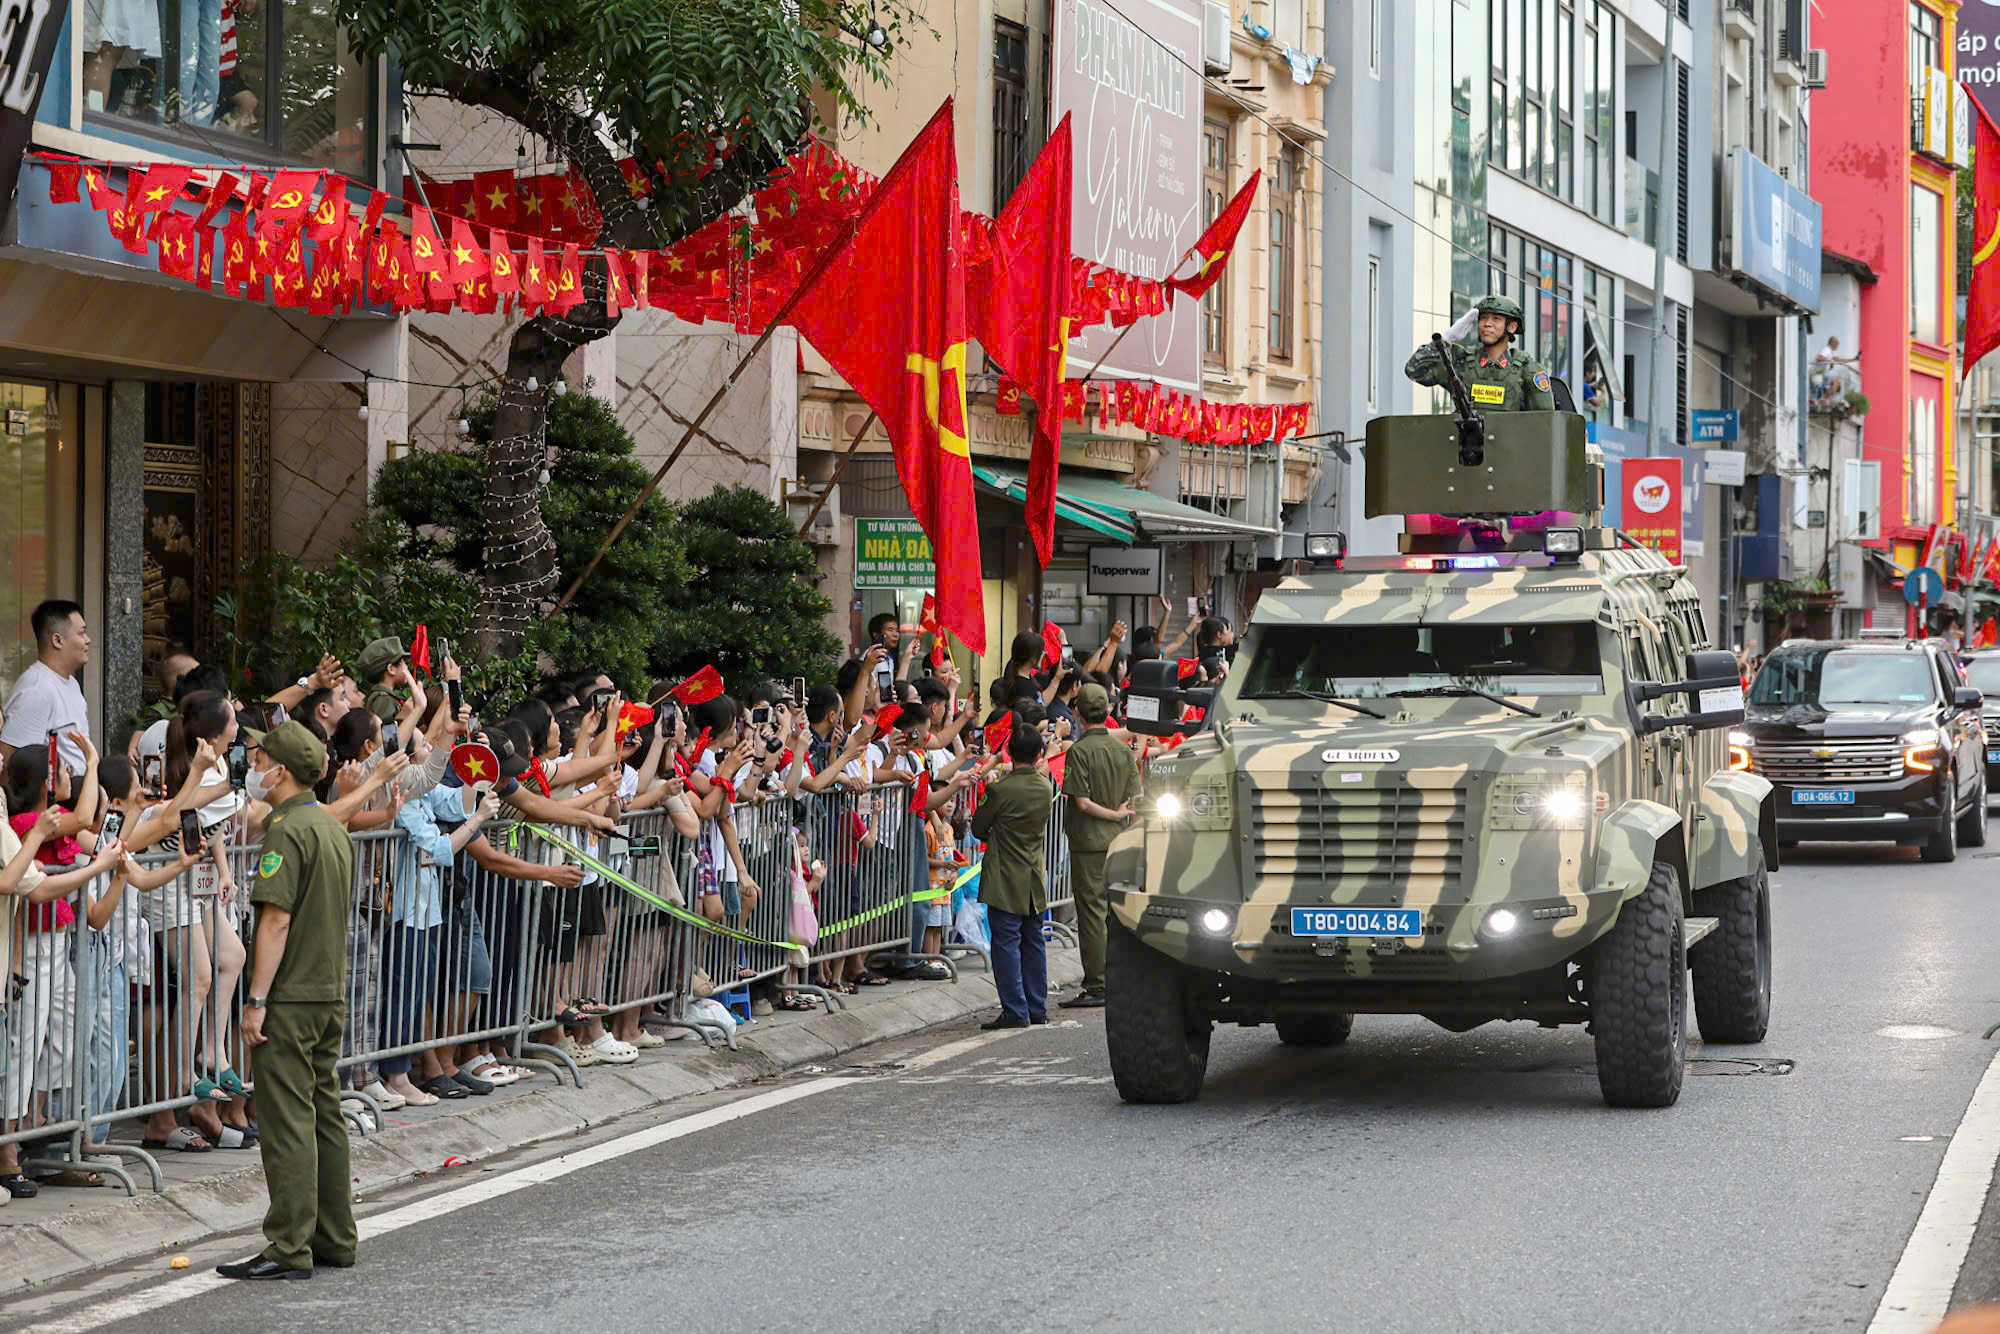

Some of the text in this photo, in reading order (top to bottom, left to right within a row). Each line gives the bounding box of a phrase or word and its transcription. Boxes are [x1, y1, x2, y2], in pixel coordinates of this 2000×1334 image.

[1075, 0, 1185, 119] PHAN ANH
[1115, 248, 1127, 272] ART
[1137, 254, 1157, 279] CRAFT
[1701, 425, 1724, 437] ATM
[865, 536, 902, 558] NHÀ
[858, 562, 876, 571] MUA
[908, 562, 924, 571] CHO
[1092, 565, 1151, 576] Tupperwar
[1327, 752, 1394, 760] GUARDIAN
[1797, 792, 1849, 802] 80A-066.12
[197, 877, 214, 889] STOP
[1303, 913, 1410, 931] T80-004.84
